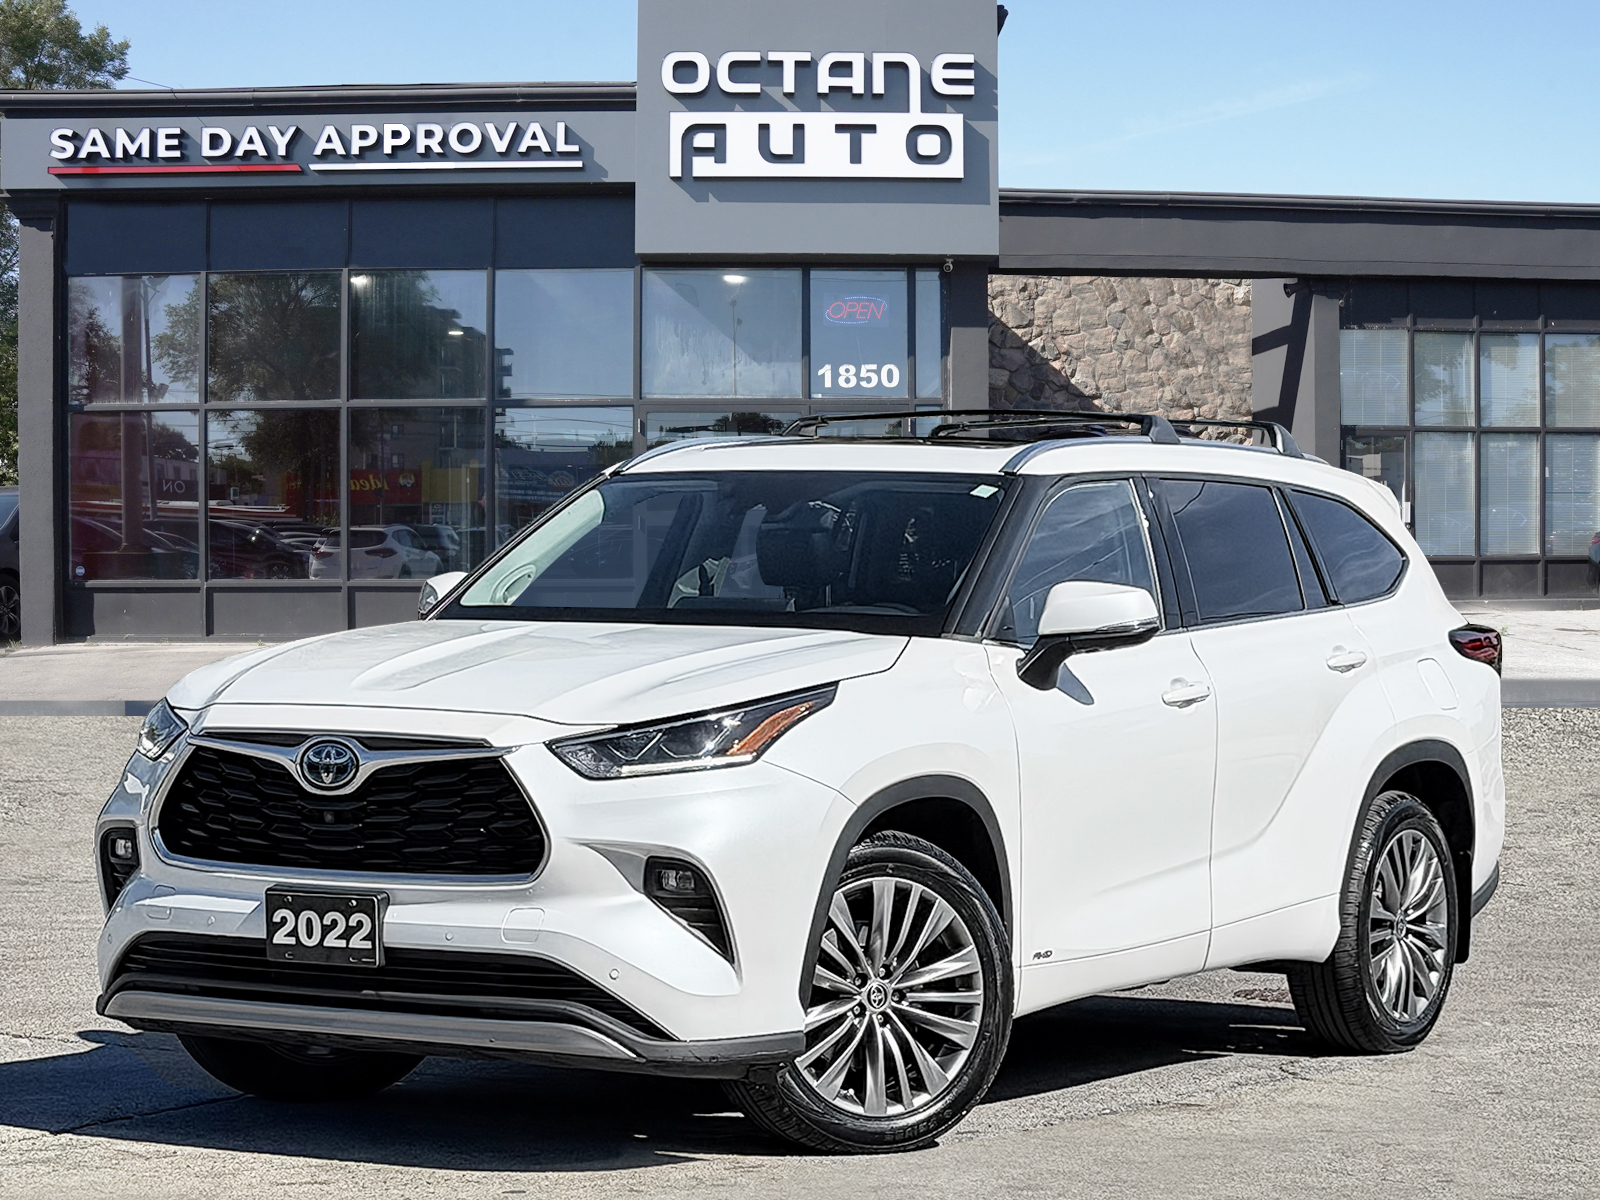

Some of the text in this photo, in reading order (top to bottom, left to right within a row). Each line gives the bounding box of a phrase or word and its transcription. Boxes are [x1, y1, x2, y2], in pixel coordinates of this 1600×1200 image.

[661, 51, 975, 104] OCTANE
[49, 121, 581, 160] SAME DAY APPROVAL
[681, 123, 953, 177] AUTO
[829, 302, 885, 319] OPEN
[818, 364, 900, 388] 1850
[272, 909, 373, 949] 2022
